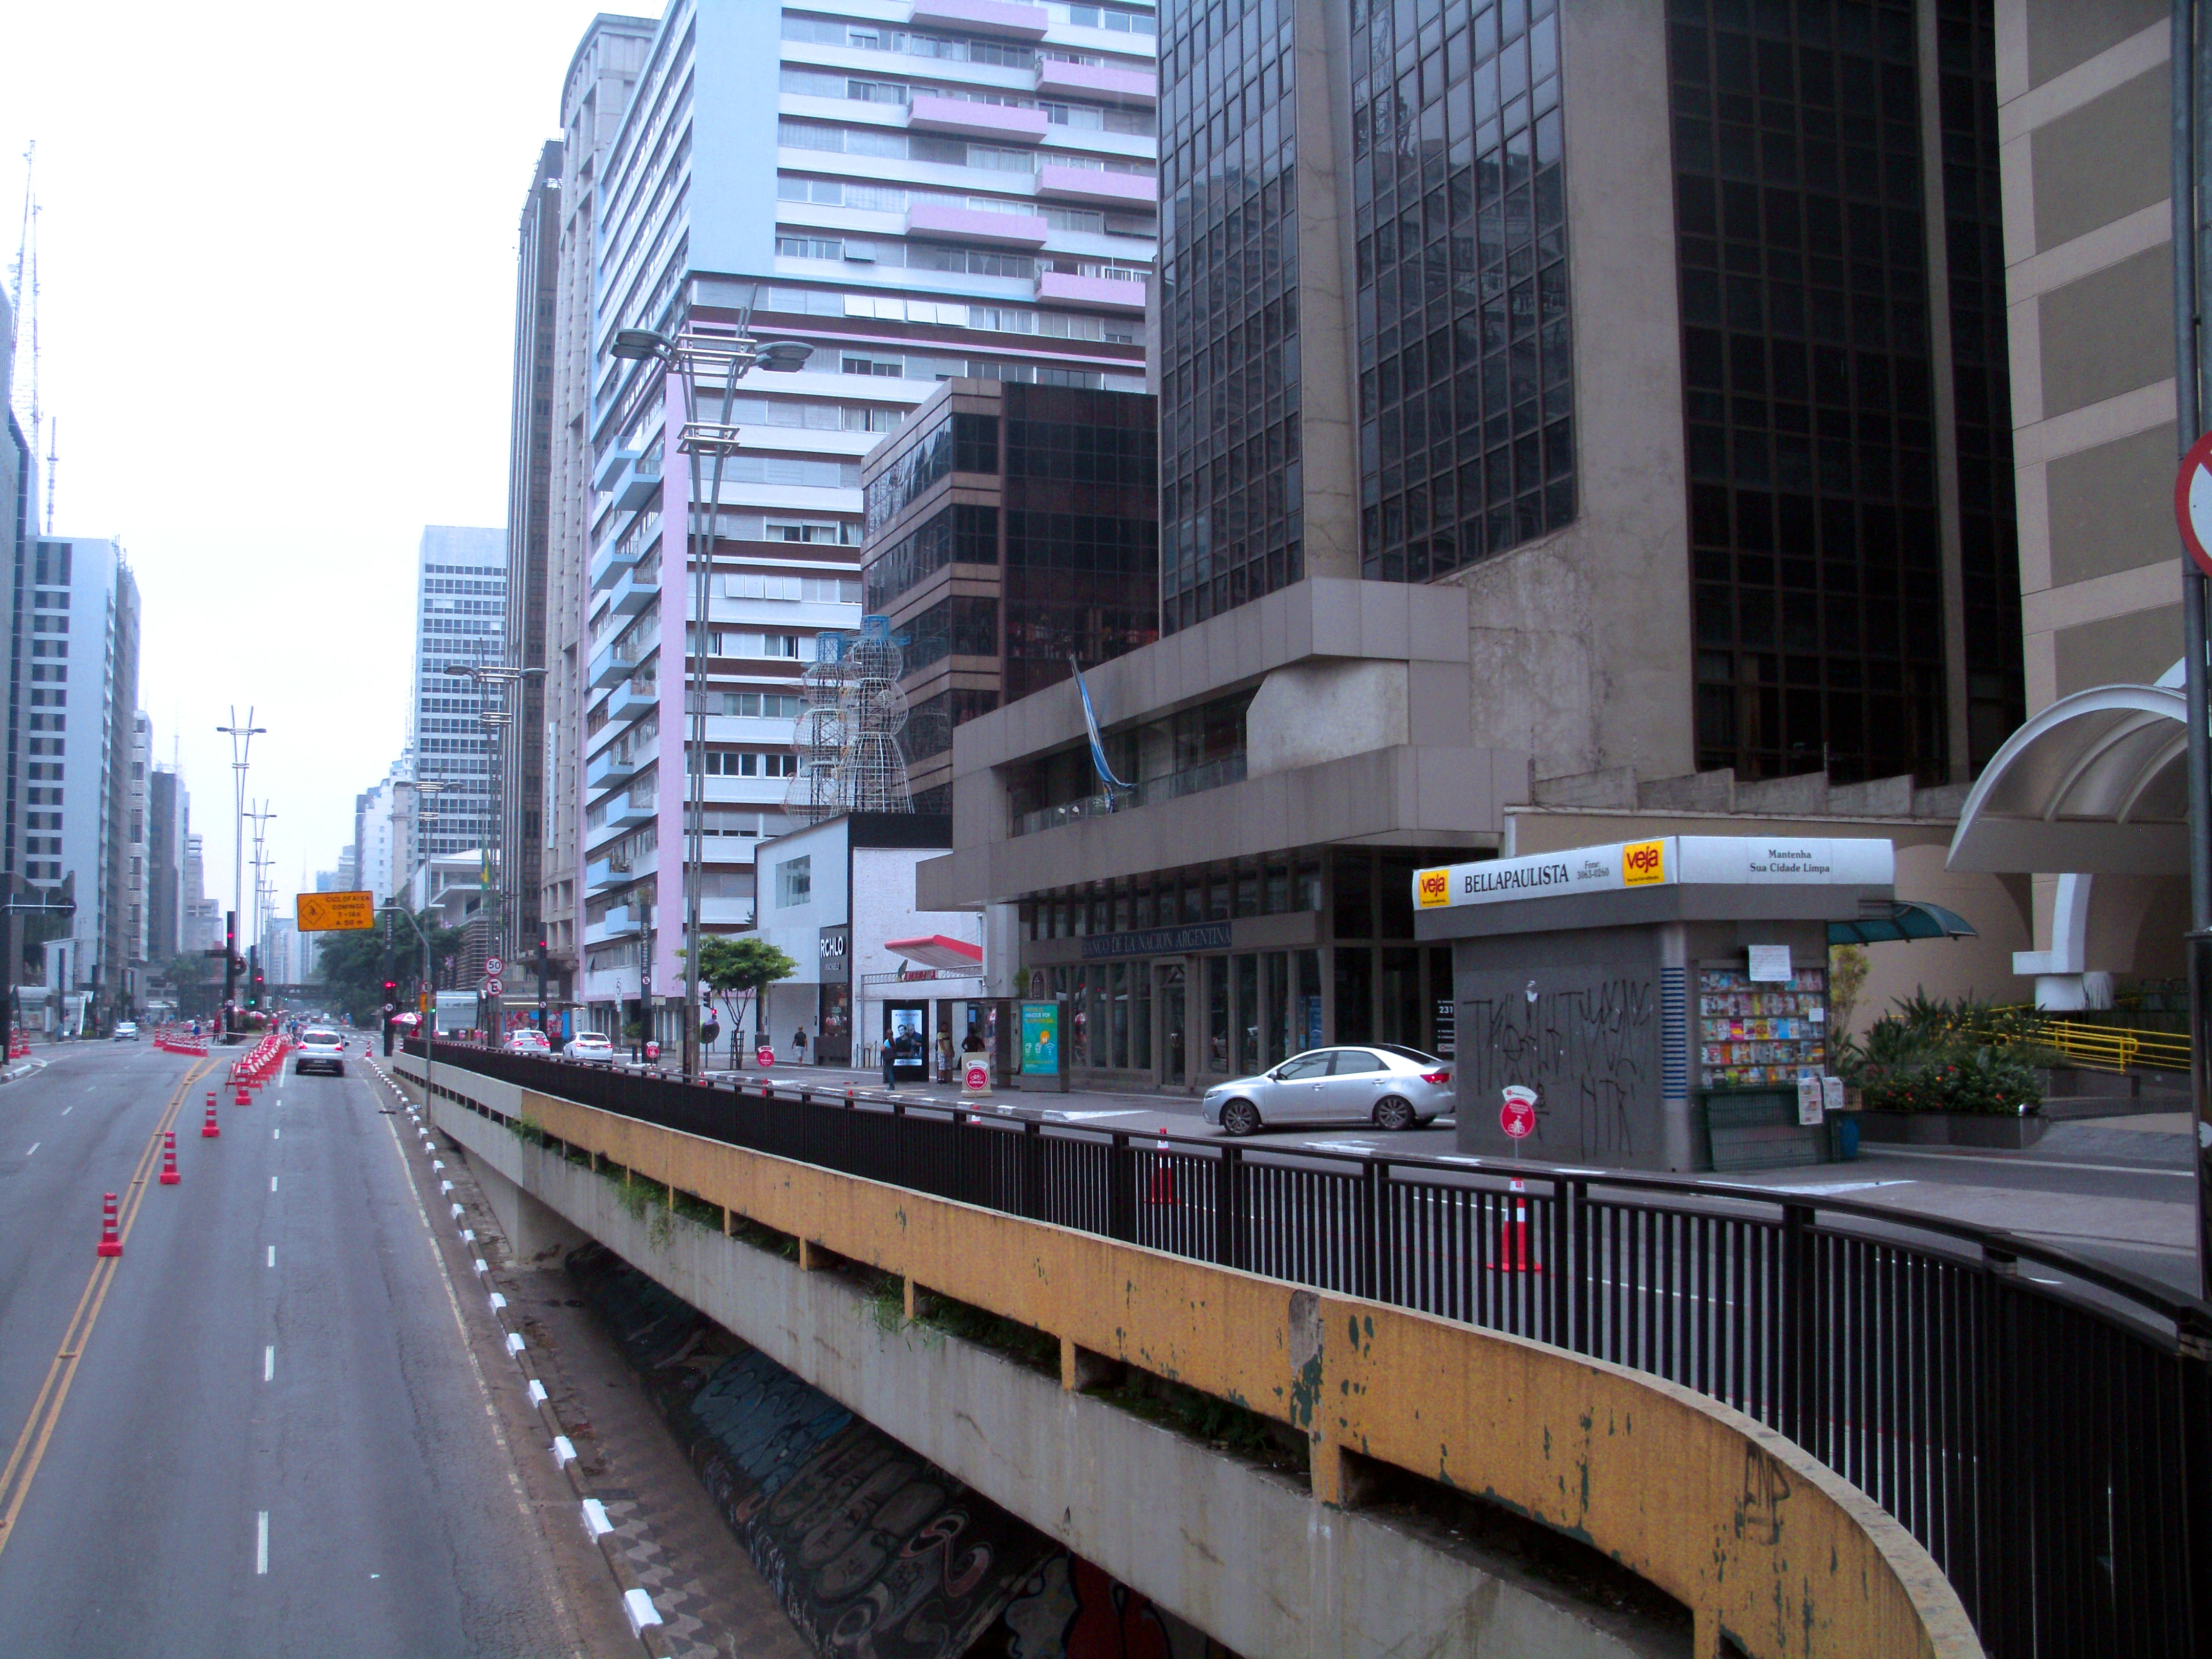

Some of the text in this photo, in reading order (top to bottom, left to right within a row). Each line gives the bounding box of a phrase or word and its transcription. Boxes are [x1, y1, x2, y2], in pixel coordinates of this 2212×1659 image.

[1585, 860, 1601, 869] Fone:
[1627, 845, 1658, 874] veja
[1768, 849, 1812, 858] Mantenha
[1464, 863, 1569, 894] BELLAPAULISTA
[1750, 862, 1830, 874] Sua Cidade Limpa
[1421, 874, 1445, 897] veja
[820, 936, 843, 958] RCHLO
[1083, 938, 1109, 955] BANCO
[1112, 937, 1121, 952] DE
[1124, 936, 1136, 952] LA
[1175, 926, 1231, 947] ARGENTINA
[488, 961, 501, 969] 50
